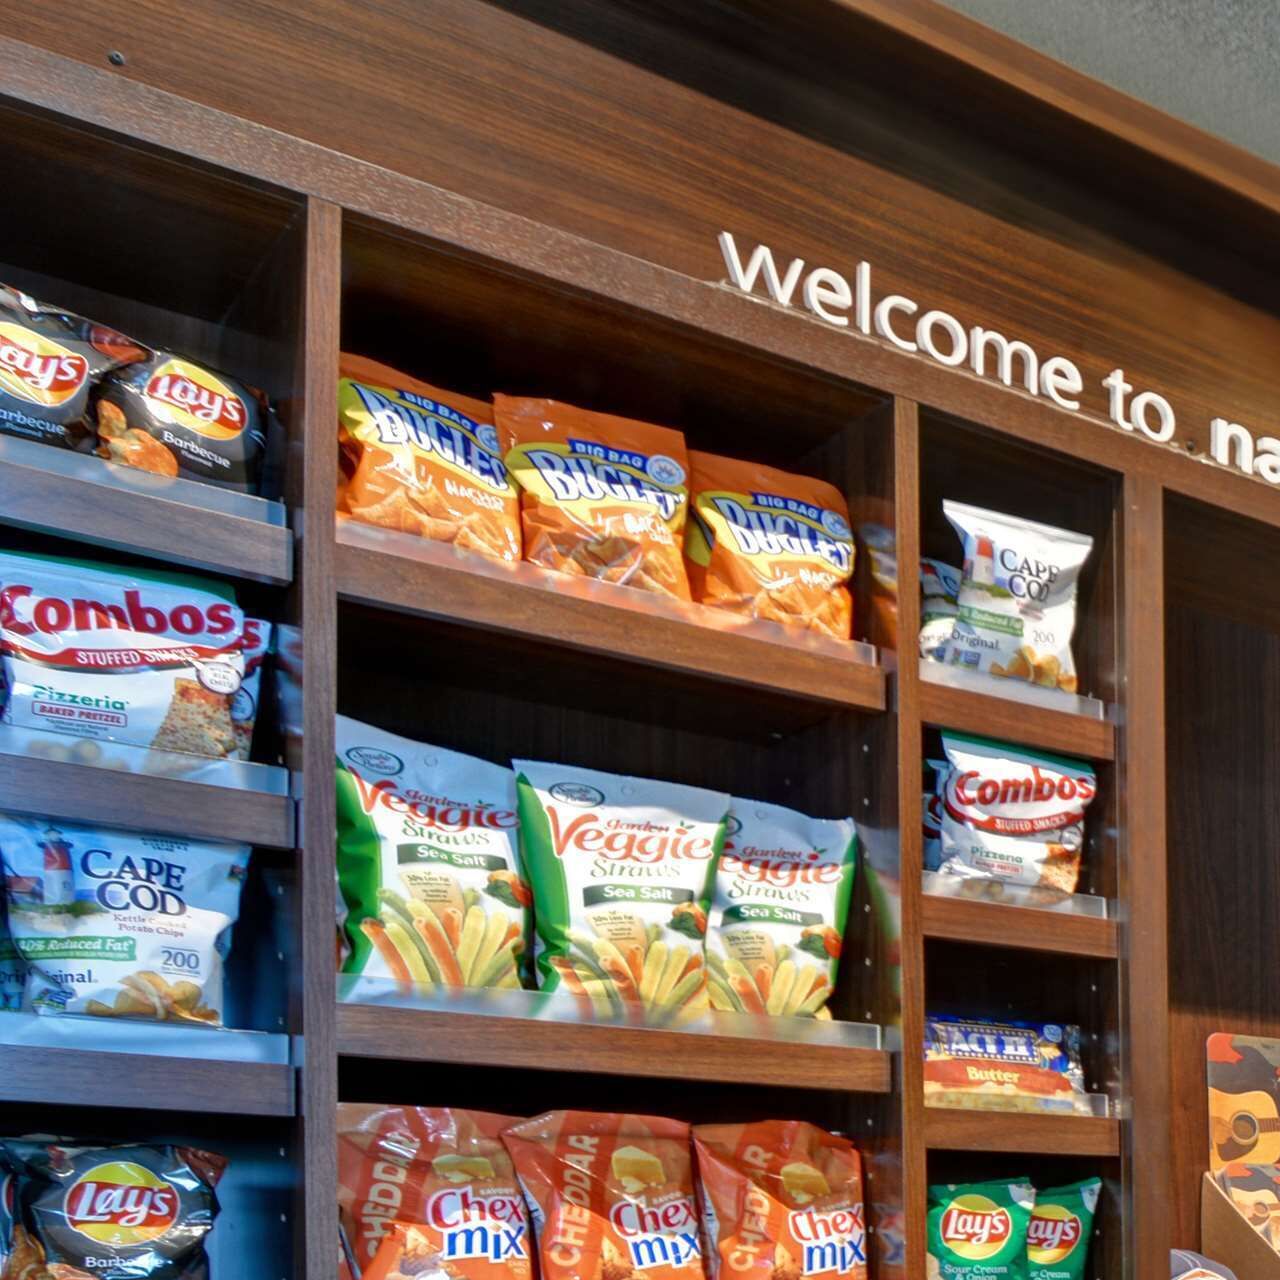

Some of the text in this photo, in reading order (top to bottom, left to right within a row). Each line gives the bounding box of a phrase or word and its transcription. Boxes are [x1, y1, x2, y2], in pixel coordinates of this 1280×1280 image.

[718, 230, 1083, 412] welcome
[1102, 368, 1176, 443] to
[146, 371, 244, 428] Lay's
[403, 393, 472, 431] BIG BAG
[162, 430, 232, 471] Barbecue
[353, 382, 510, 491] BUGLES
[574, 441, 647, 468] BIG BAG
[524, 450, 686, 520] BUGLES
[756, 492, 820, 521] BIG BAG
[713, 497, 853, 571] BUGLES
[1, 584, 236, 635] Combos
[76, 648, 199, 666] STUFFED SNACKS
[952, 629, 999, 650] Original
[32, 684, 126, 711] Pizzeria
[39, 704, 122, 724] BAKED PRETZEL
[348, 767, 520, 832] Veggie
[405, 788, 470, 809] garden
[955, 766, 1096, 806] Combos
[401, 821, 490, 847] Straws
[547, 805, 714, 864] Veggie
[604, 818, 669, 834] garden
[80, 849, 186, 891] CAPE
[416, 846, 486, 868] Sea Salt
[590, 859, 681, 879] Straws
[740, 846, 803, 861] garden
[96, 881, 187, 916] COD
[604, 884, 673, 902] Sea Salt
[728, 883, 810, 904] Straws
[117, 923, 184, 938] Potato Chips
[739, 904, 802, 924] Sea Salt
[161, 950, 200, 969] 200
[966, 1066, 1020, 1083] Butter
[68, 1183, 172, 1226] Lay's
[431, 1189, 525, 1234] Chex
[550, 1133, 599, 1268] CHEDDAR
[611, 1199, 697, 1238] Chex
[790, 1205, 863, 1243] Chex
[945, 1210, 1005, 1245] Lay's
[445, 1224, 526, 1260] mix
[631, 1232, 701, 1267] mix
[803, 1238, 867, 1273] mix
[944, 1265, 1008, 1274] Sour Cream
